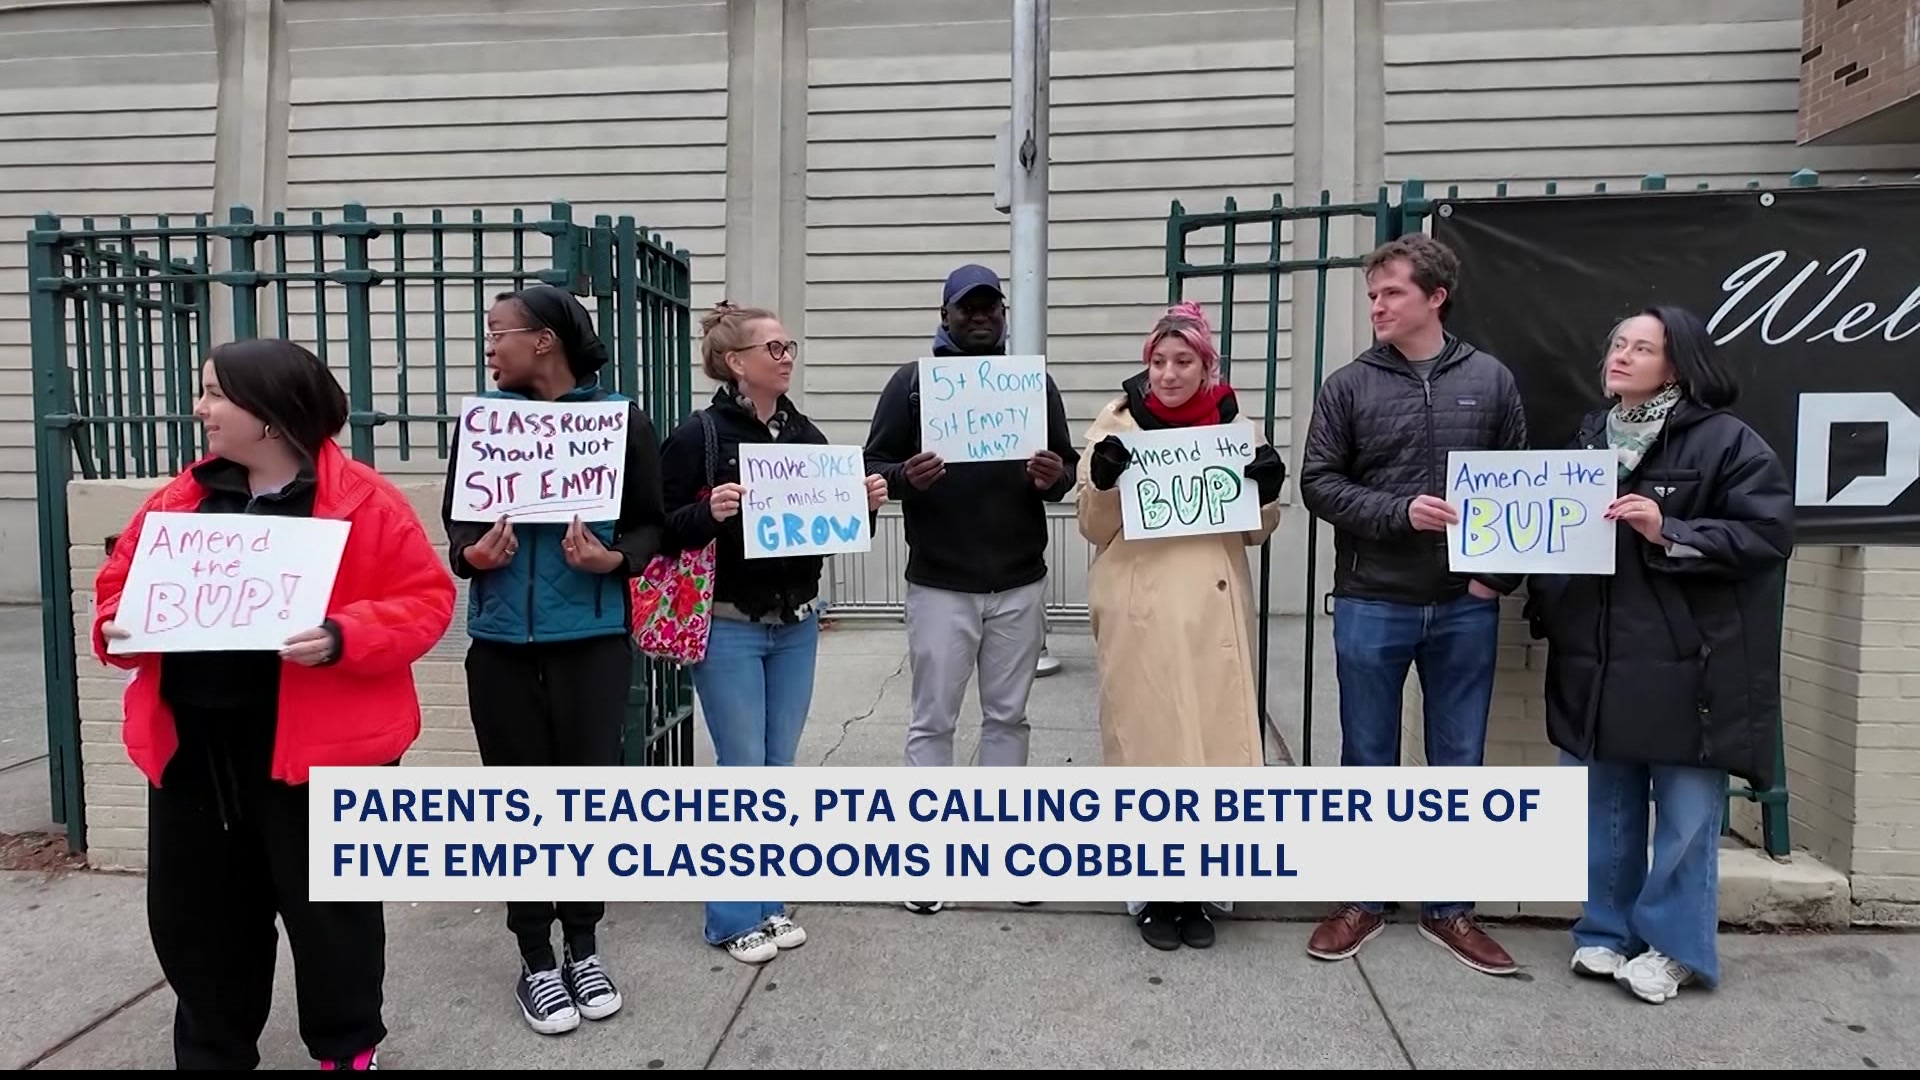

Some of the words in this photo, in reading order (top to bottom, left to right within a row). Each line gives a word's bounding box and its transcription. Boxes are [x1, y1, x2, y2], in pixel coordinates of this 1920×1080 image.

[932, 366, 967, 401] 5+
[465, 406, 624, 437] CLASSROOMS
[808, 453, 856, 478] SPACE
[1126, 440, 1201, 475] Amend
[1216, 437, 1251, 457] the
[465, 471, 523, 511] SIT
[540, 464, 617, 499] EMPTY
[1454, 460, 1548, 493] Amend
[1560, 461, 1606, 486] the
[748, 489, 774, 512] for
[787, 488, 825, 507] minds
[834, 487, 850, 502] to
[1136, 466, 1241, 530] BUP
[149, 525, 271, 559] Amend
[757, 513, 861, 551] GROW
[1461, 497, 1587, 556] BUP
[191, 558, 242, 578] the
[144, 573, 302, 634] BUP!
